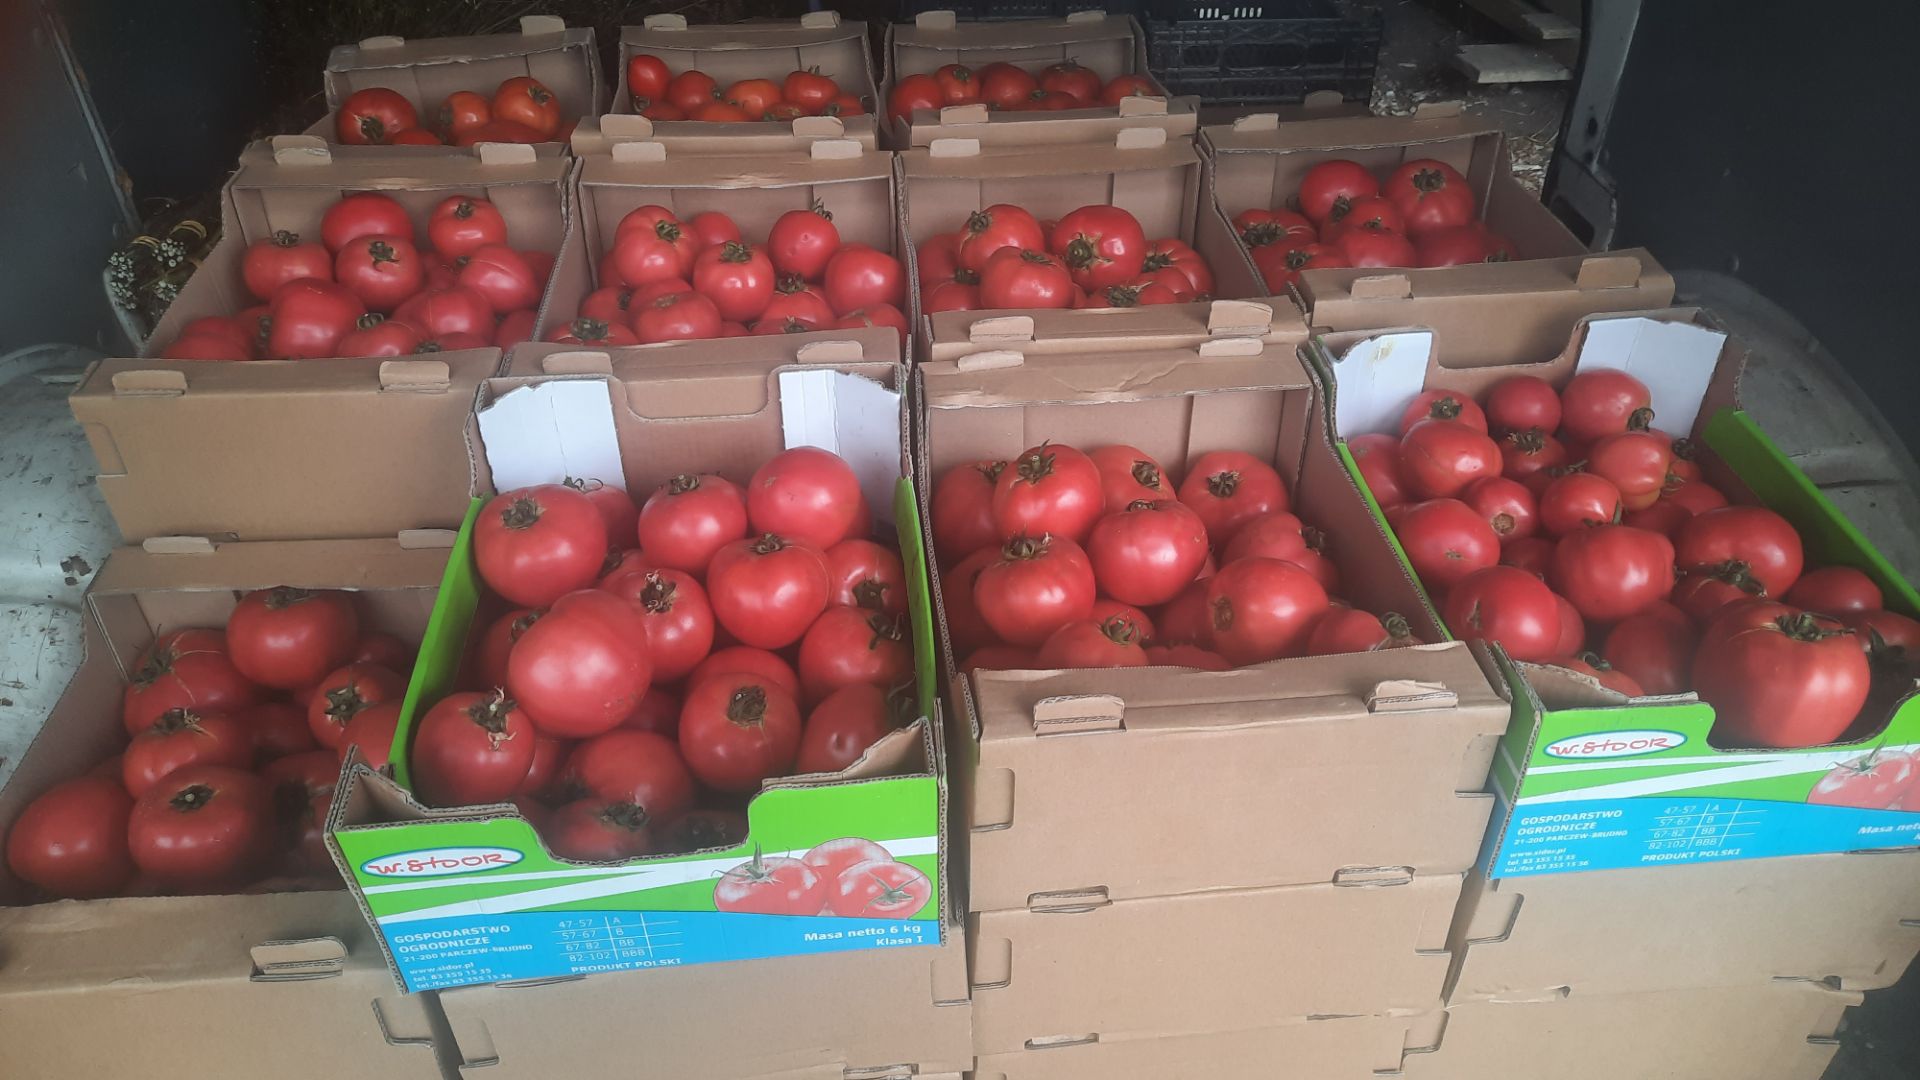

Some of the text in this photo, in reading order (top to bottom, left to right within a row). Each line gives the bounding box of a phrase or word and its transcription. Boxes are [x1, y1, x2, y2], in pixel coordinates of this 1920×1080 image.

[1664, 805, 1697, 814] 47-57
[1521, 809, 1623, 826] GOSPODARSTWO
[1659, 815, 1714, 827] 57-67 B
[1517, 821, 1598, 836] OGRODNICZE
[1653, 827, 1716, 838] 67-82 BB
[1648, 838, 1717, 850] 82-102 BBB
[1641, 848, 1741, 861] PRODUKT POLSKI
[558, 916, 621, 929] 47-57 A
[394, 925, 511, 944] GOSPODARSTWO
[561, 927, 624, 940] 57-67 B
[804, 924, 921, 941] Masa netto 6 kg
[398, 937, 490, 954] OGRODNICZE
[566, 939, 635, 951] 67-82 BB
[876, 937, 913, 946] Klasa
[568, 949, 645, 962] 82-102 BBB
[570, 958, 681, 973] PRODUKT POLSKI
